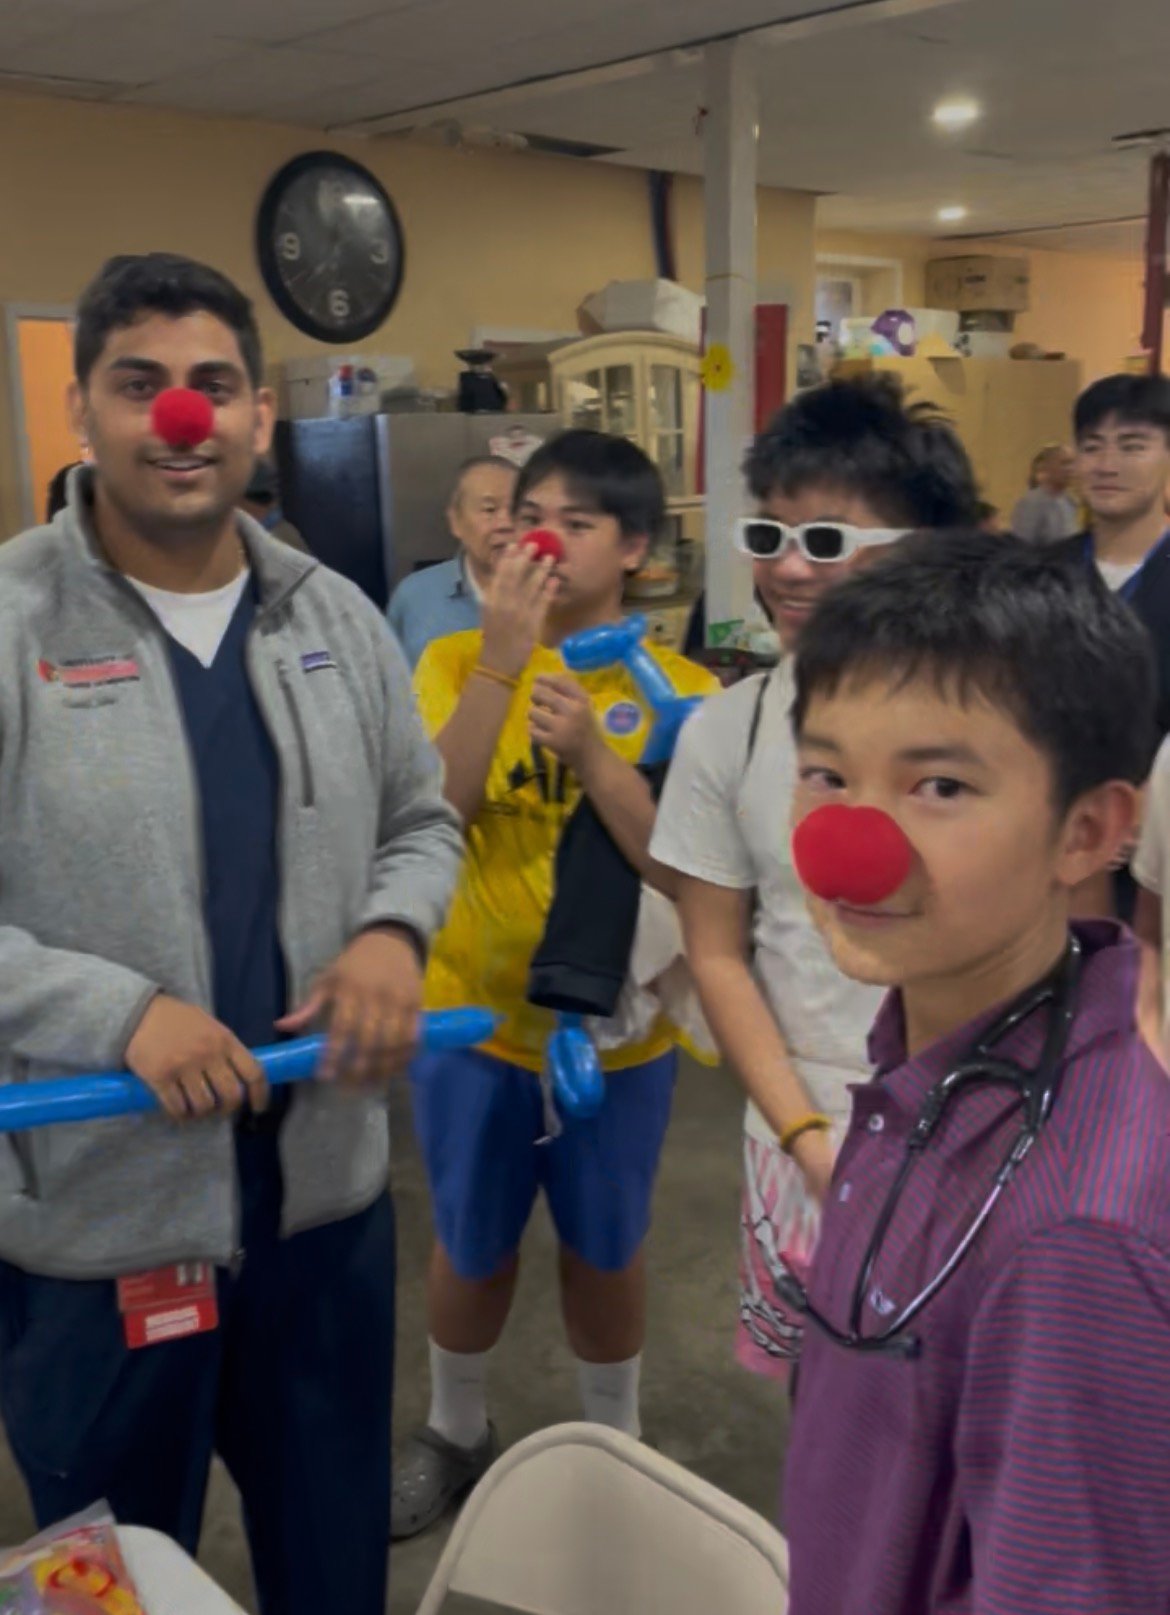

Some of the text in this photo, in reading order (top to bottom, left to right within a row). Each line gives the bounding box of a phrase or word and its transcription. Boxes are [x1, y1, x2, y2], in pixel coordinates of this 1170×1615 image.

[280, 233, 299, 260] 9
[370, 238, 388, 264] 3
[329, 289, 349, 317] 6
